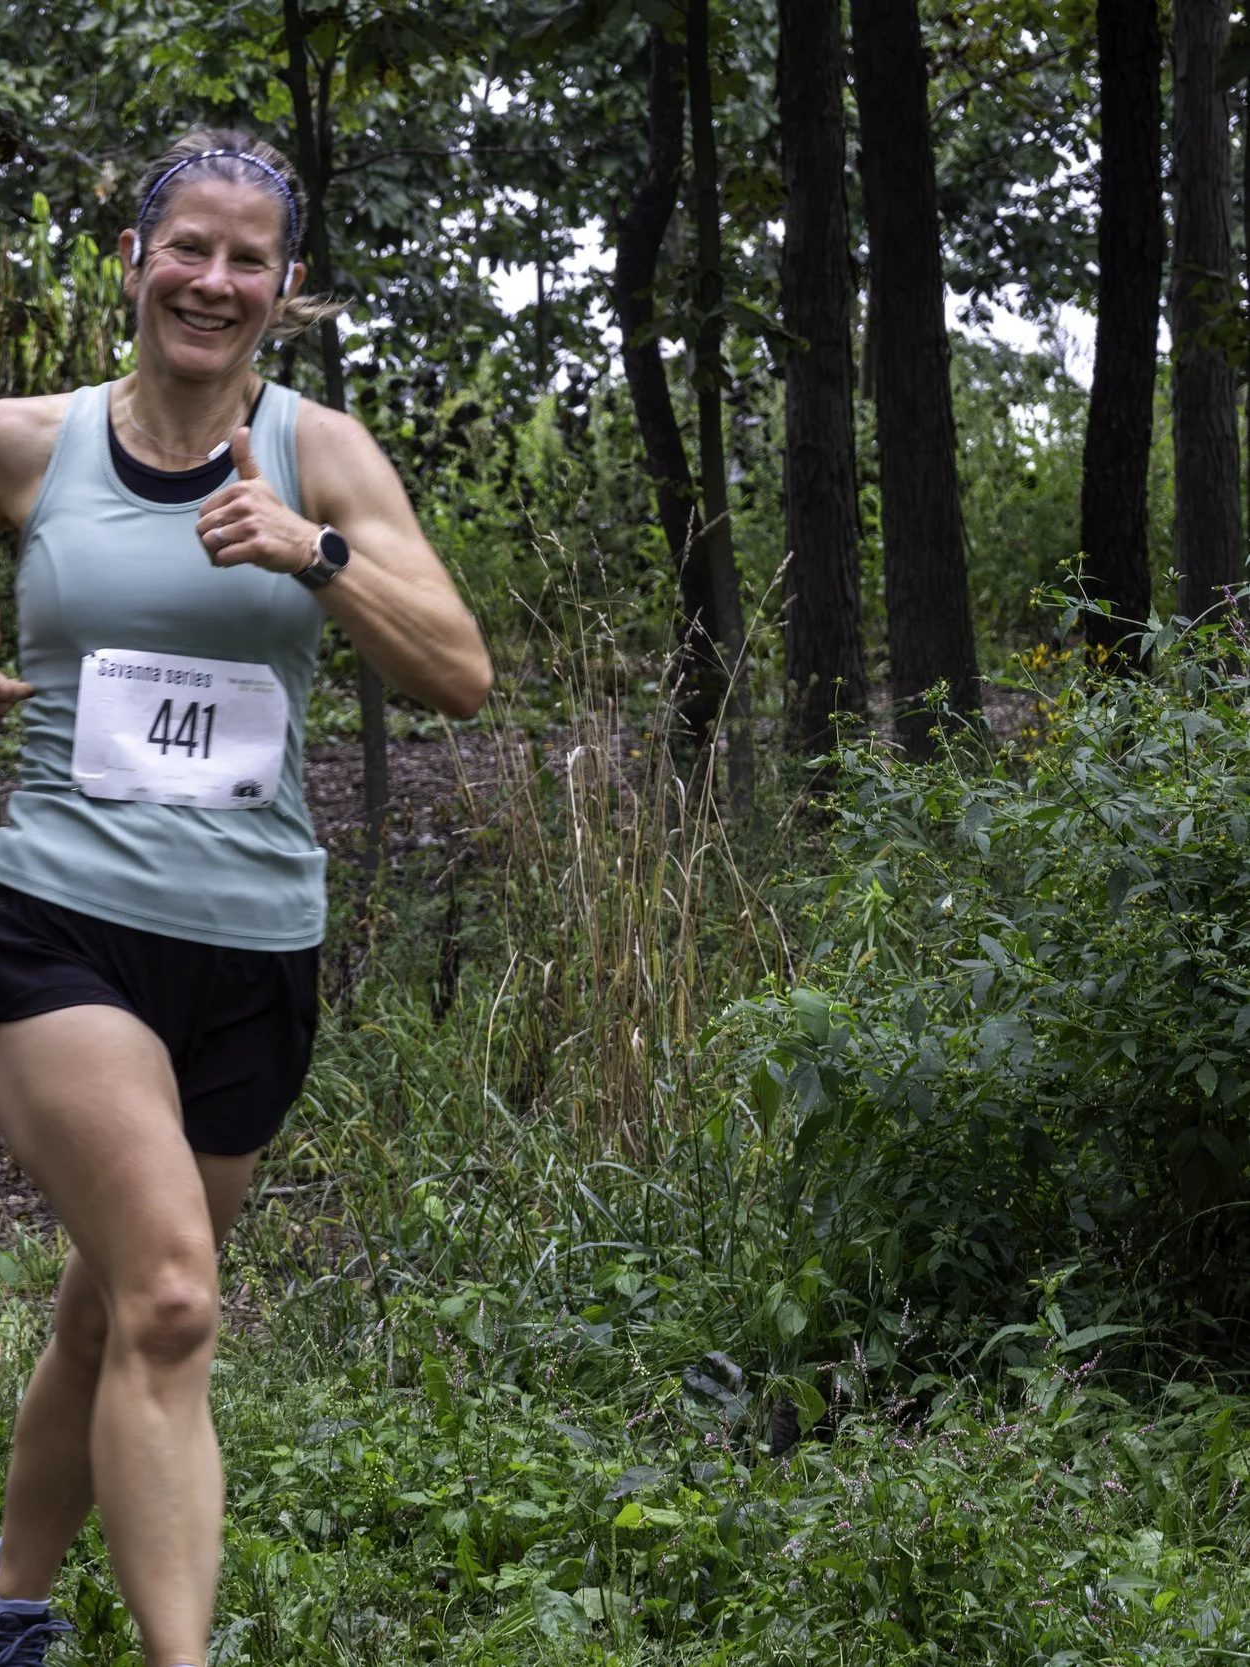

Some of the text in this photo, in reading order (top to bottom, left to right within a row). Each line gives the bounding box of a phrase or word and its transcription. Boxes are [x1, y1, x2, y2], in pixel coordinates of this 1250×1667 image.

[97, 658, 214, 688] Savanna series
[148, 698, 217, 760] 441
